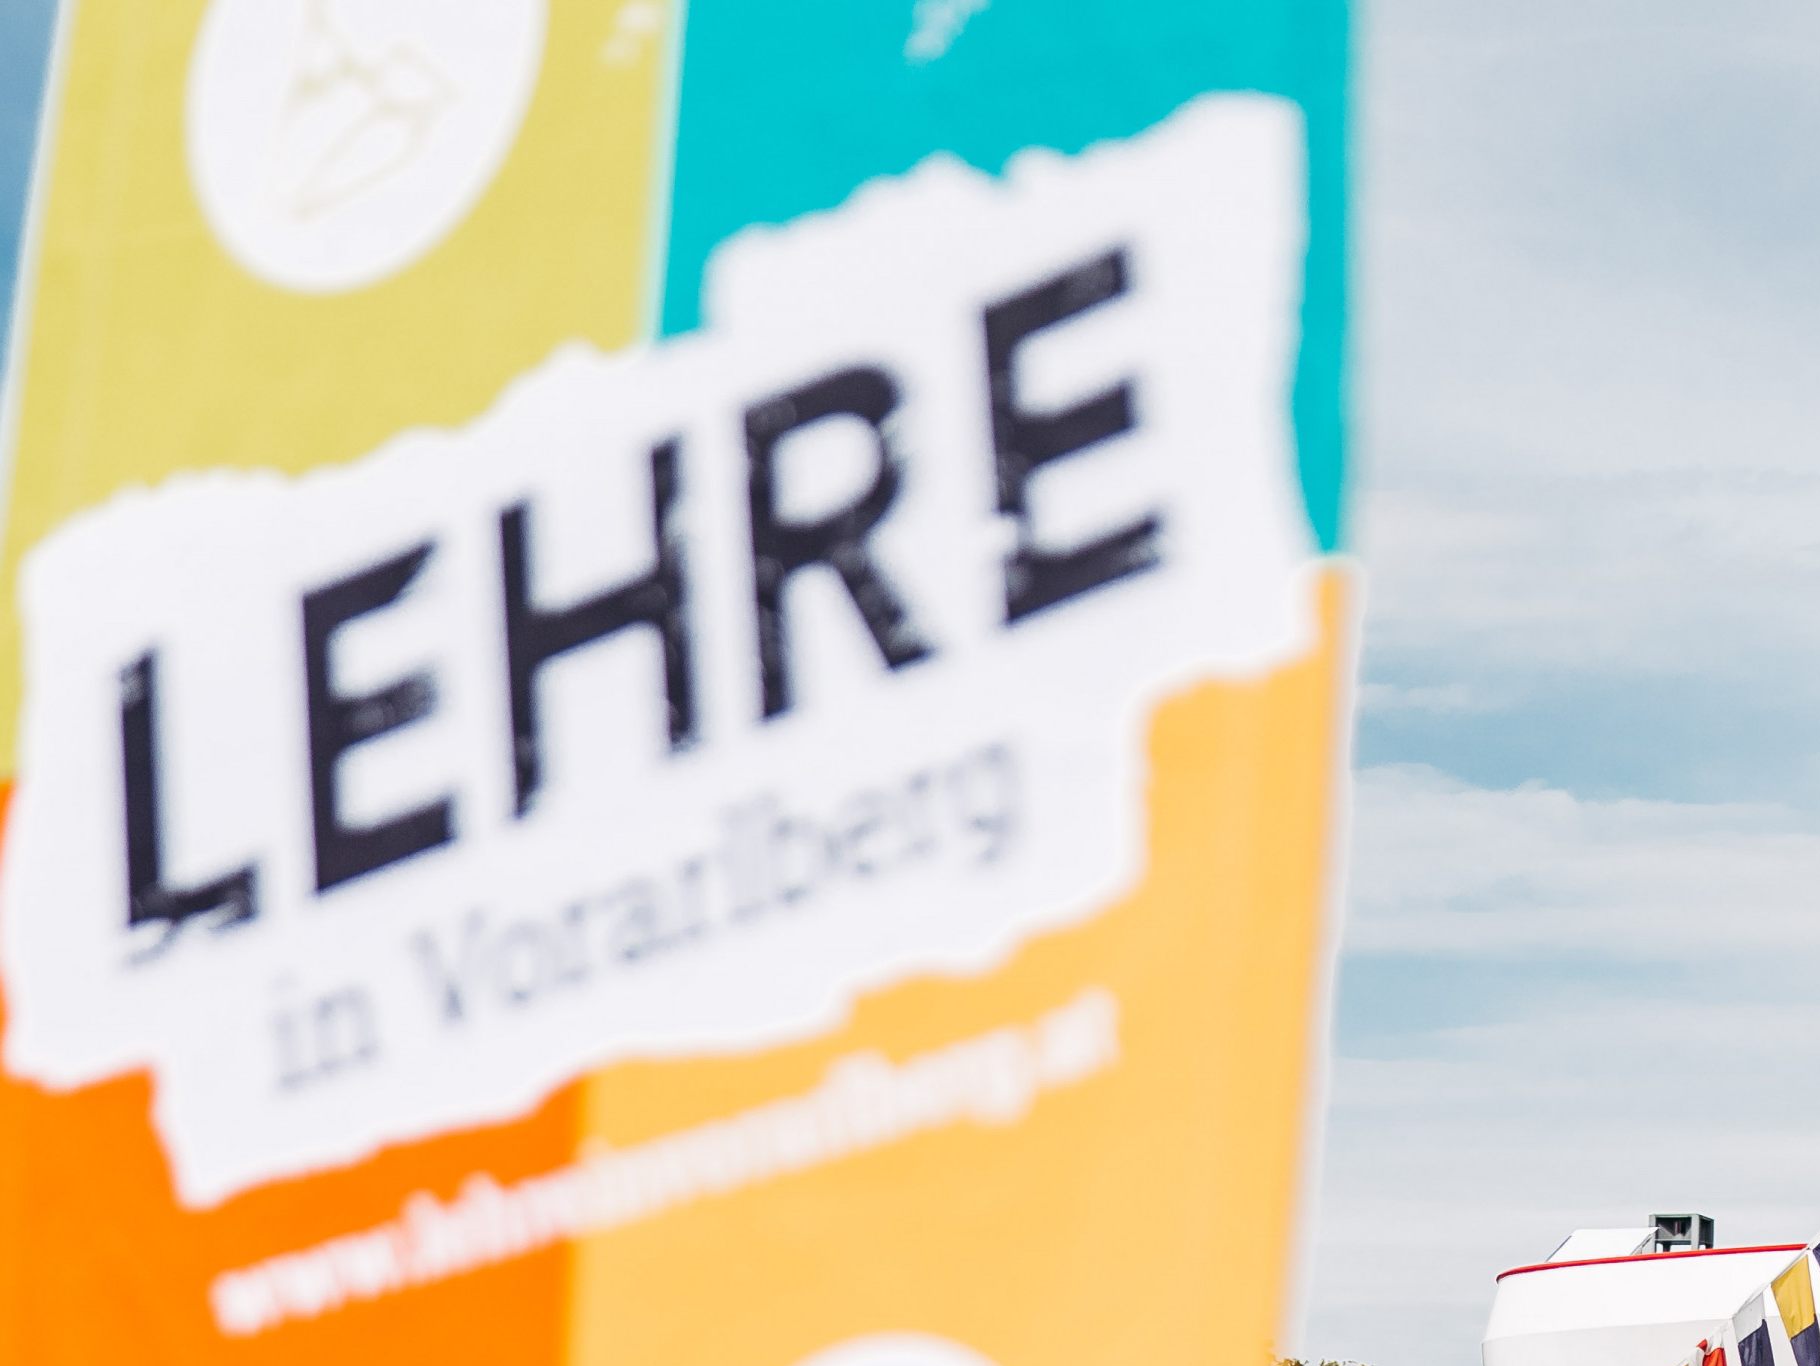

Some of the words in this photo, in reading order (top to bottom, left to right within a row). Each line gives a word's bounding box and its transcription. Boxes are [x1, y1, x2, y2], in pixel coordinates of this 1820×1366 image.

[115, 243, 1170, 966] LEHRE
[272, 982, 374, 1095] in
[408, 738, 1026, 1026] Vorarlberg
